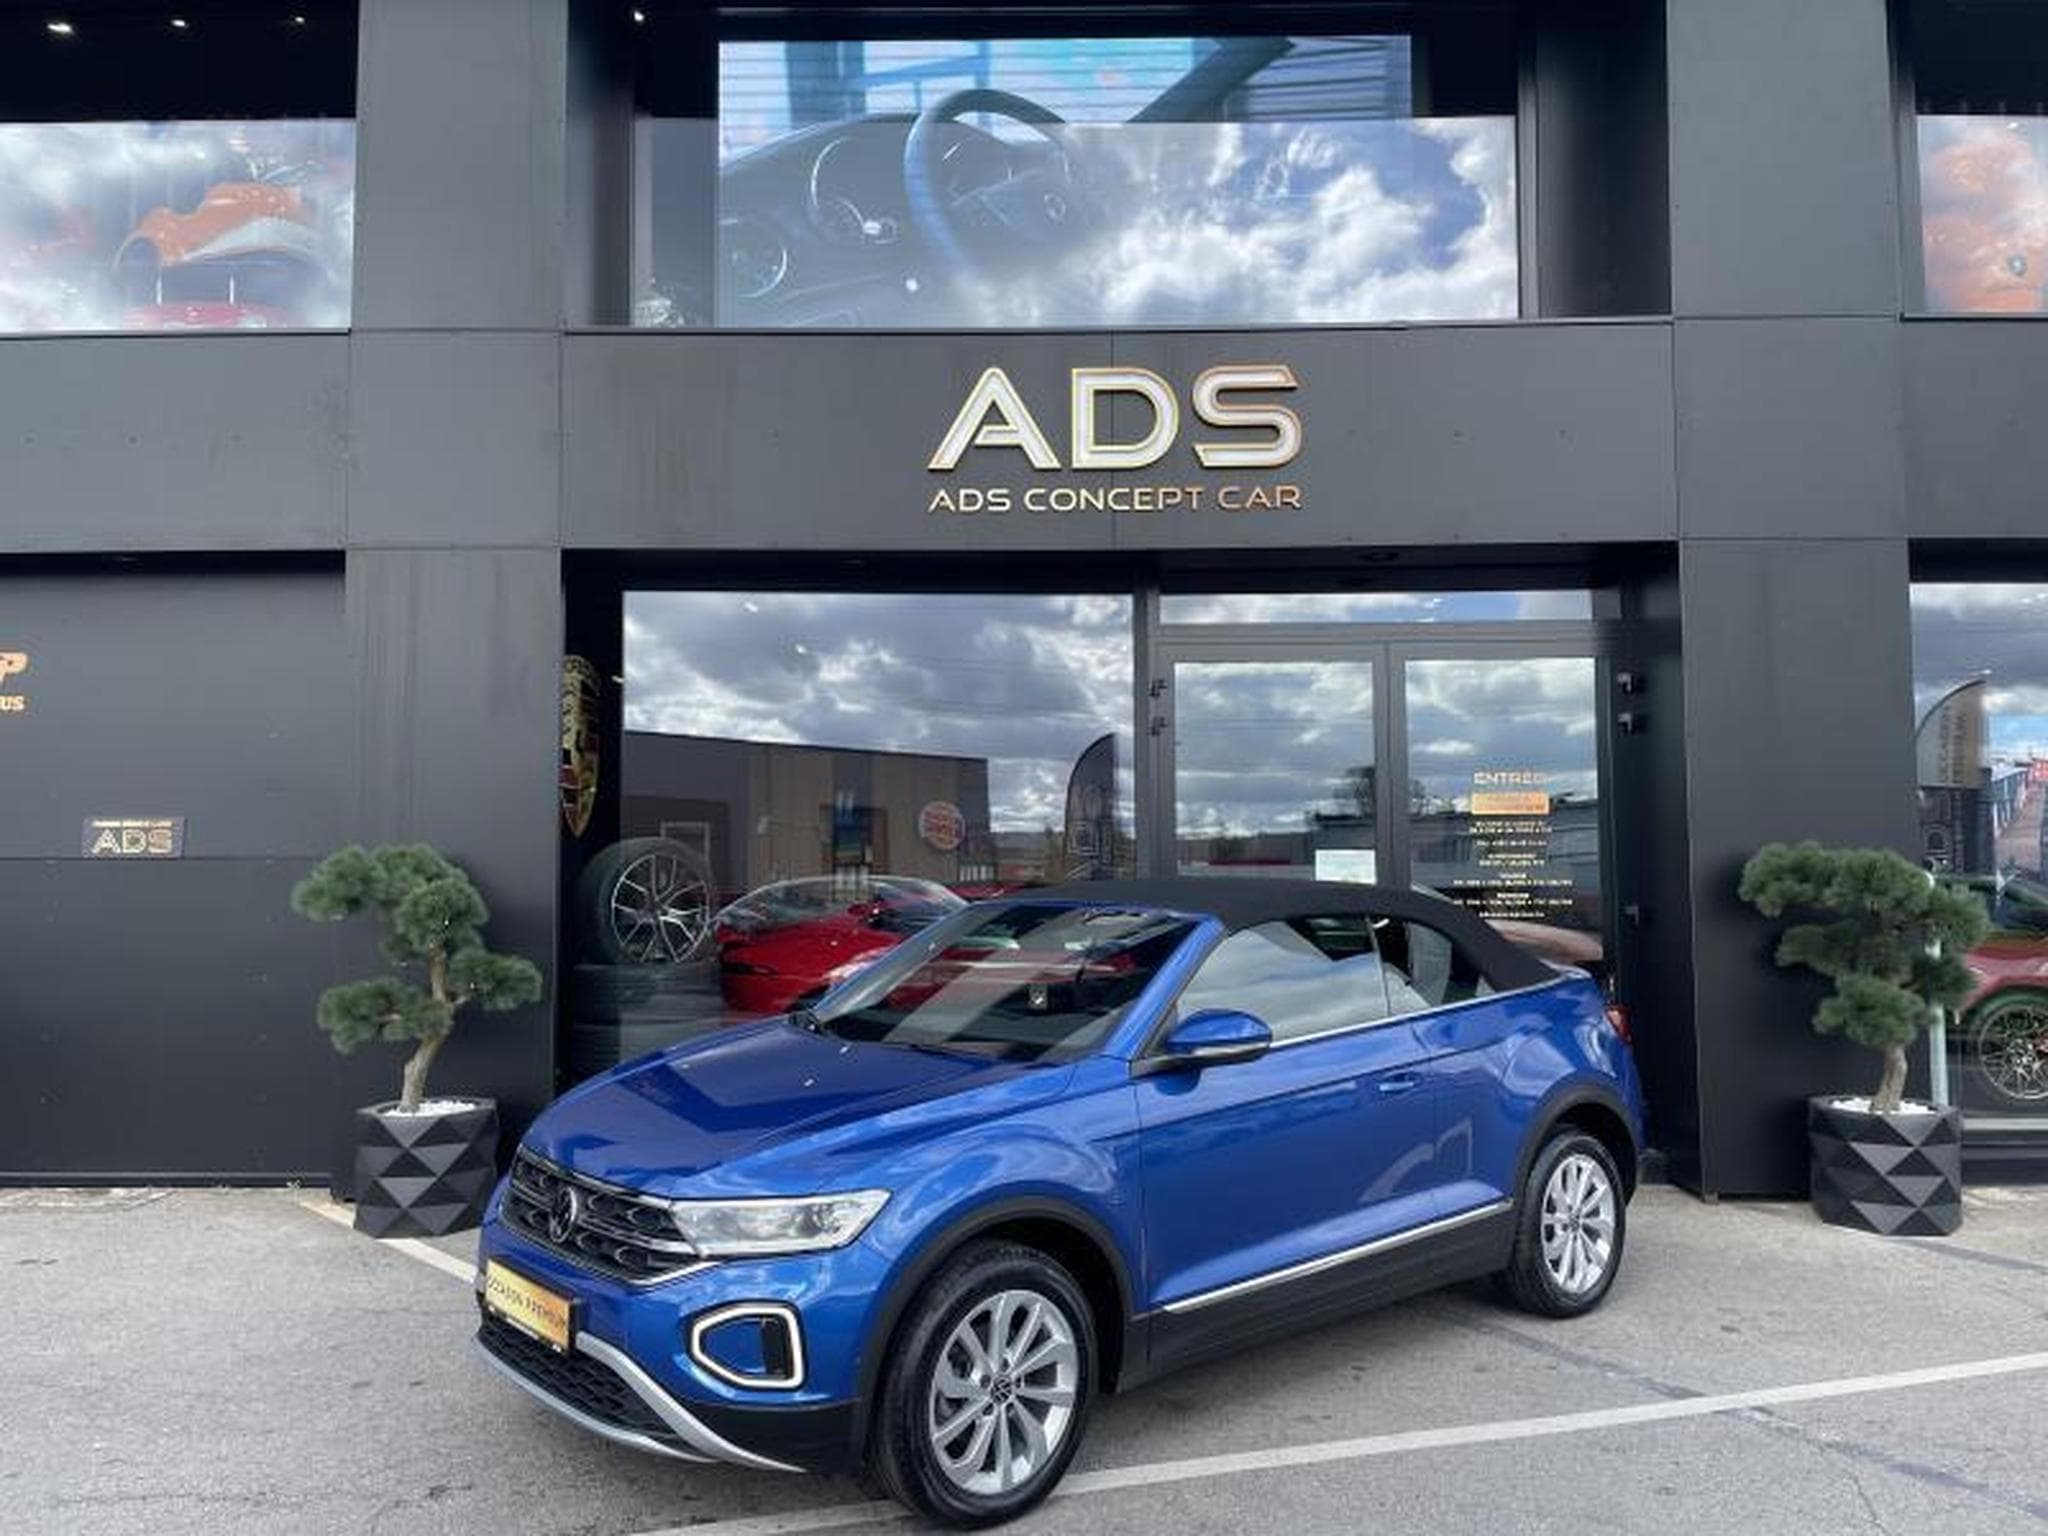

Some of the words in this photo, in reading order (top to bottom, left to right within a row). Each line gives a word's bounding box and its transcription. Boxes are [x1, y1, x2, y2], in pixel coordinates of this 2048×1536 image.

[928, 365, 1301, 470] ADS
[928, 488, 1011, 512] ADS
[1023, 487, 1203, 512] CONCEPT
[1218, 486, 1302, 510] CAR
